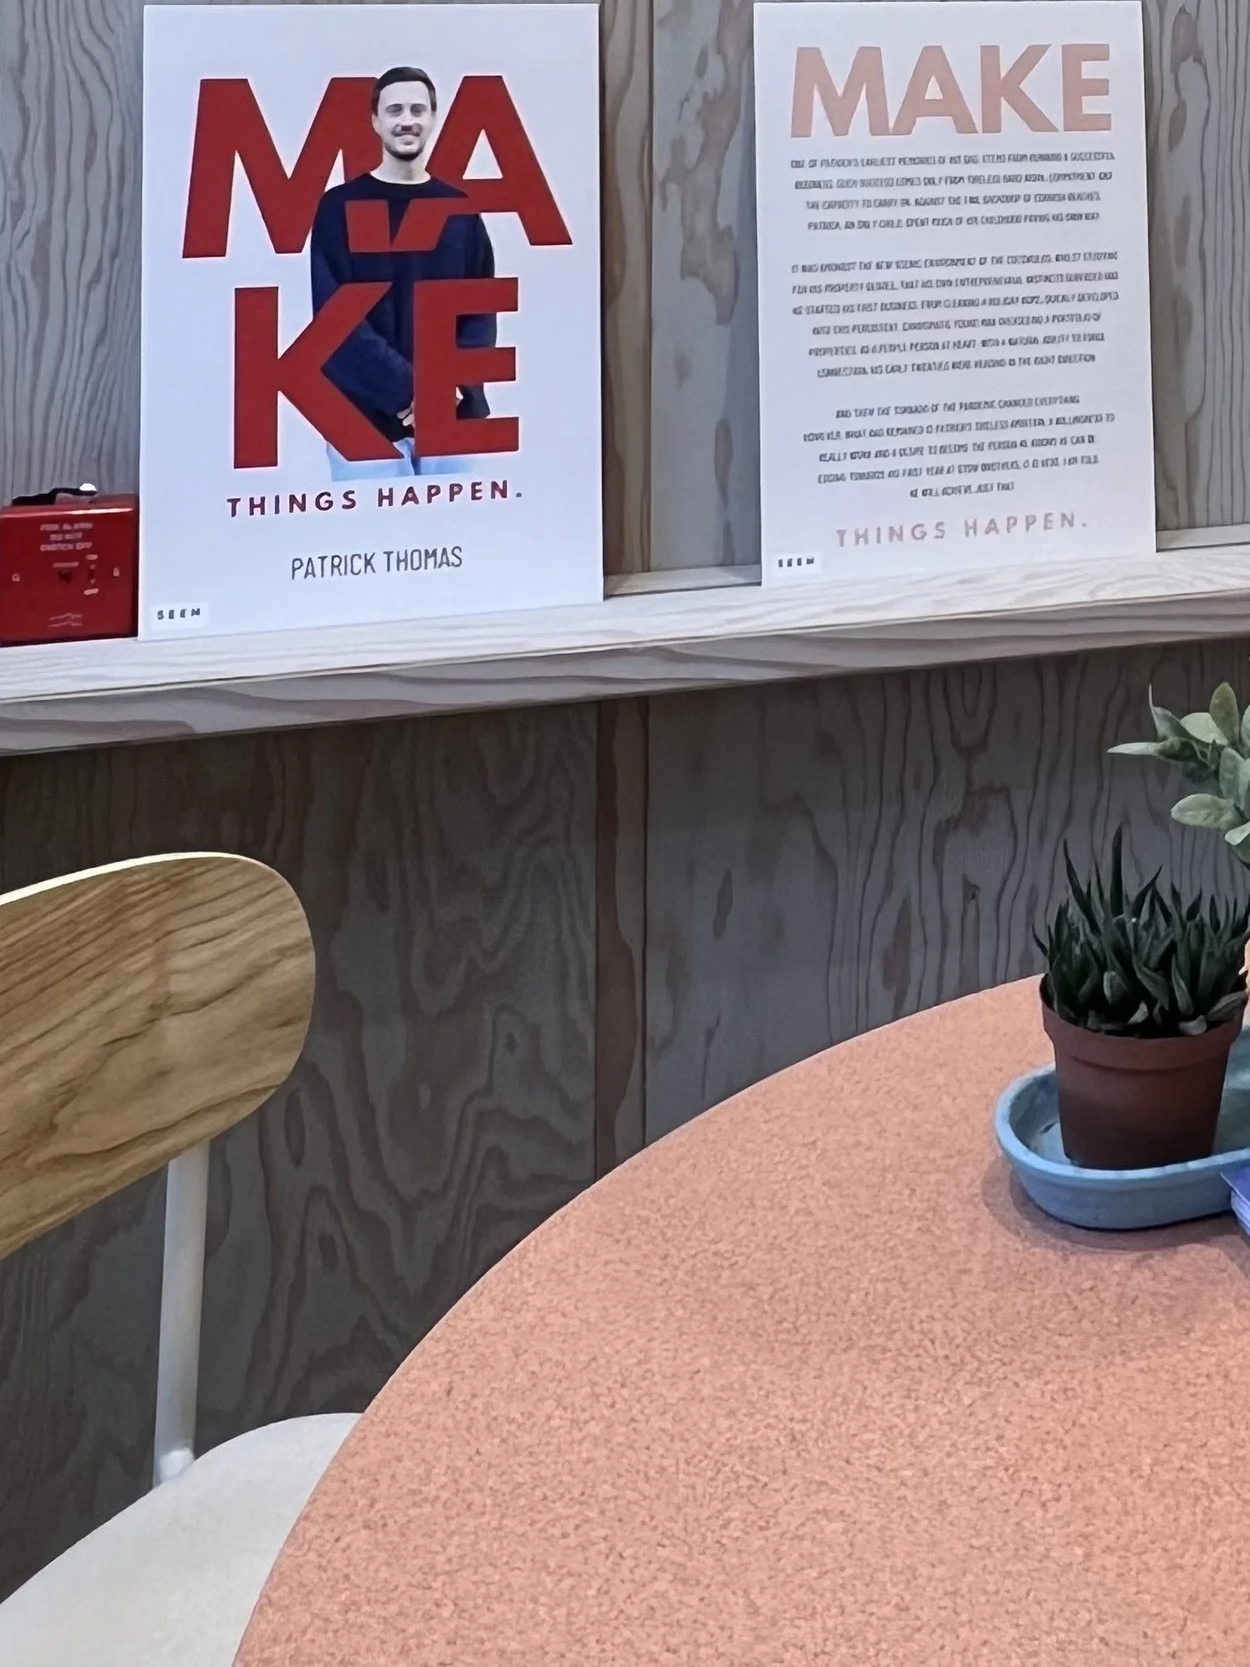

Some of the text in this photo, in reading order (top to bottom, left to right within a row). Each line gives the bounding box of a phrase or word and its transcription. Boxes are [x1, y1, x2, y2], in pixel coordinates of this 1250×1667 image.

[790, 43, 1112, 139] MAKE
[233, 276, 520, 470] KE
[226, 479, 523, 518] THINGS HAPPEN.
[836, 511, 1088, 547] THINGS HAPPEN.
[291, 545, 463, 581] PATRICK THOMAS
